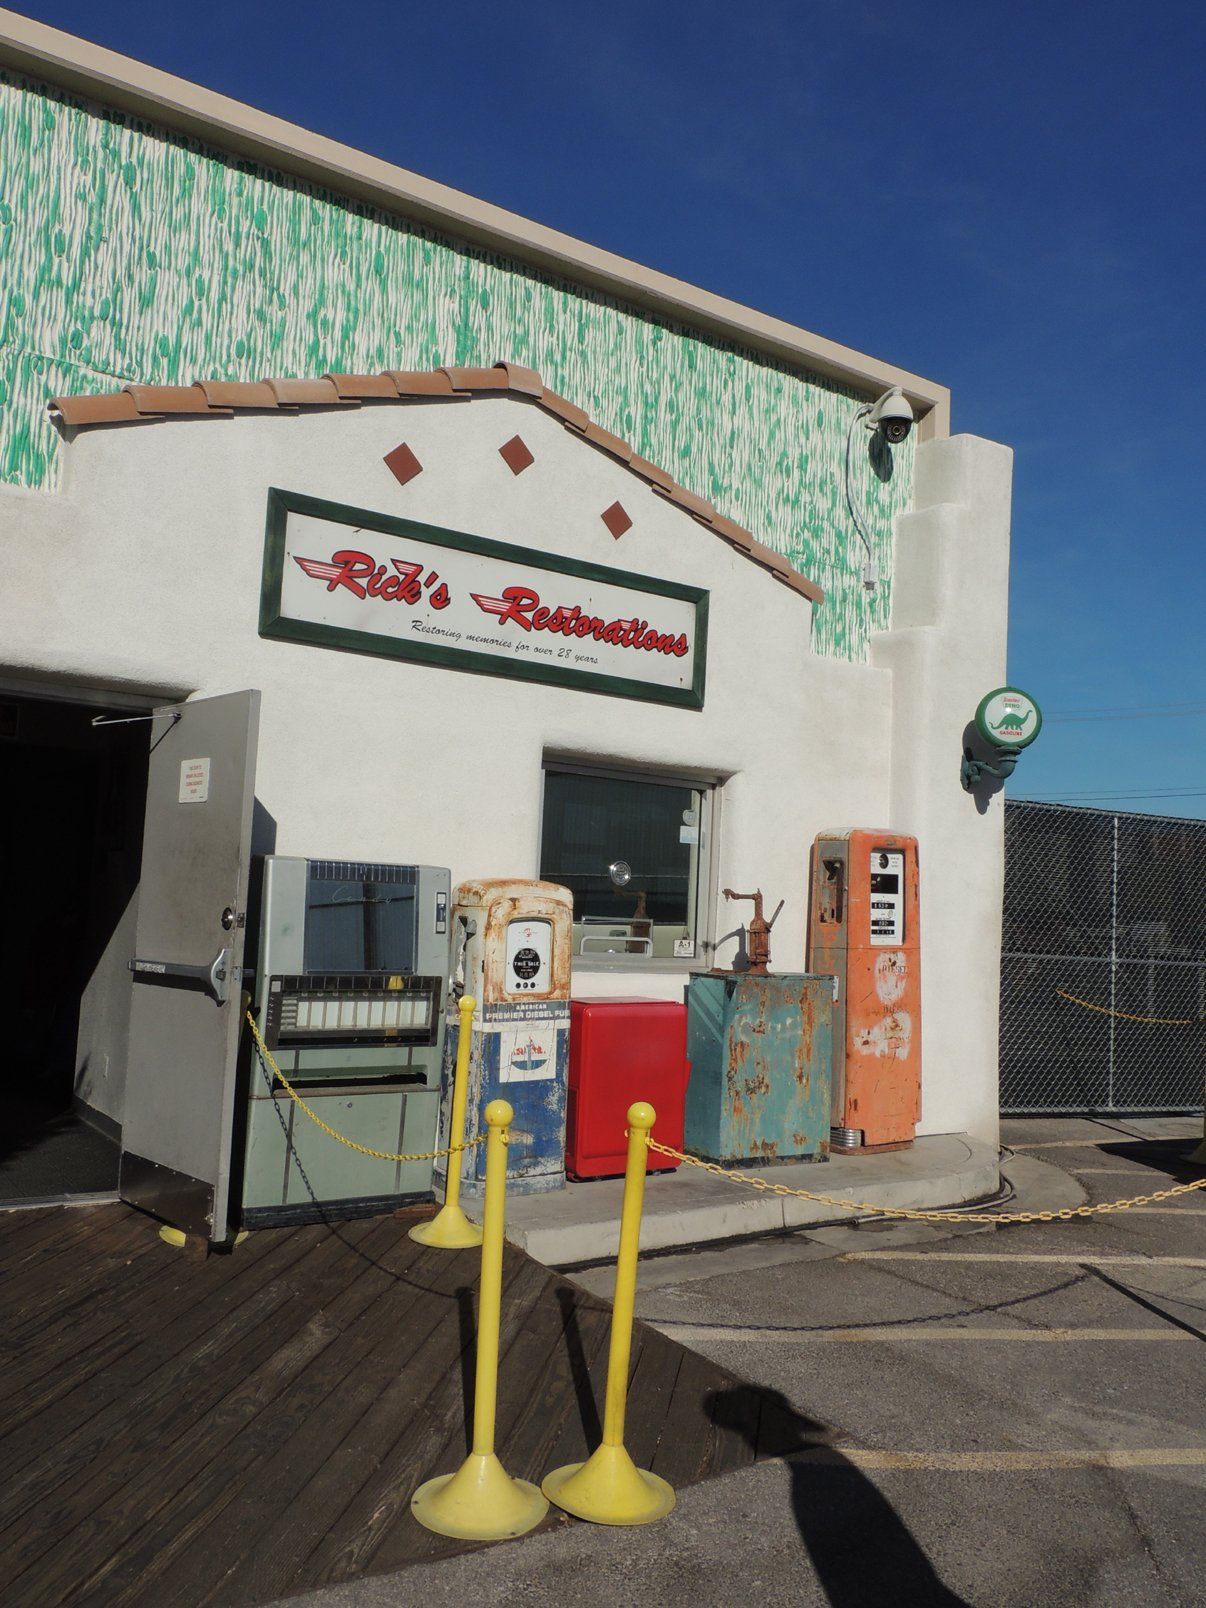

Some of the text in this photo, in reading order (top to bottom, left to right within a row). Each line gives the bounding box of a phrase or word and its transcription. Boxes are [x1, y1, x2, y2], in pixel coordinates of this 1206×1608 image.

[293, 550, 689, 658] Rick's Restorations
[411, 619, 599, 664] Restoring memories for over 28 years
[485, 1011, 524, 1020] PREMIER
[525, 1010, 554, 1019] DIESEL
[515, 1003, 547, 1011] AMERICAN
